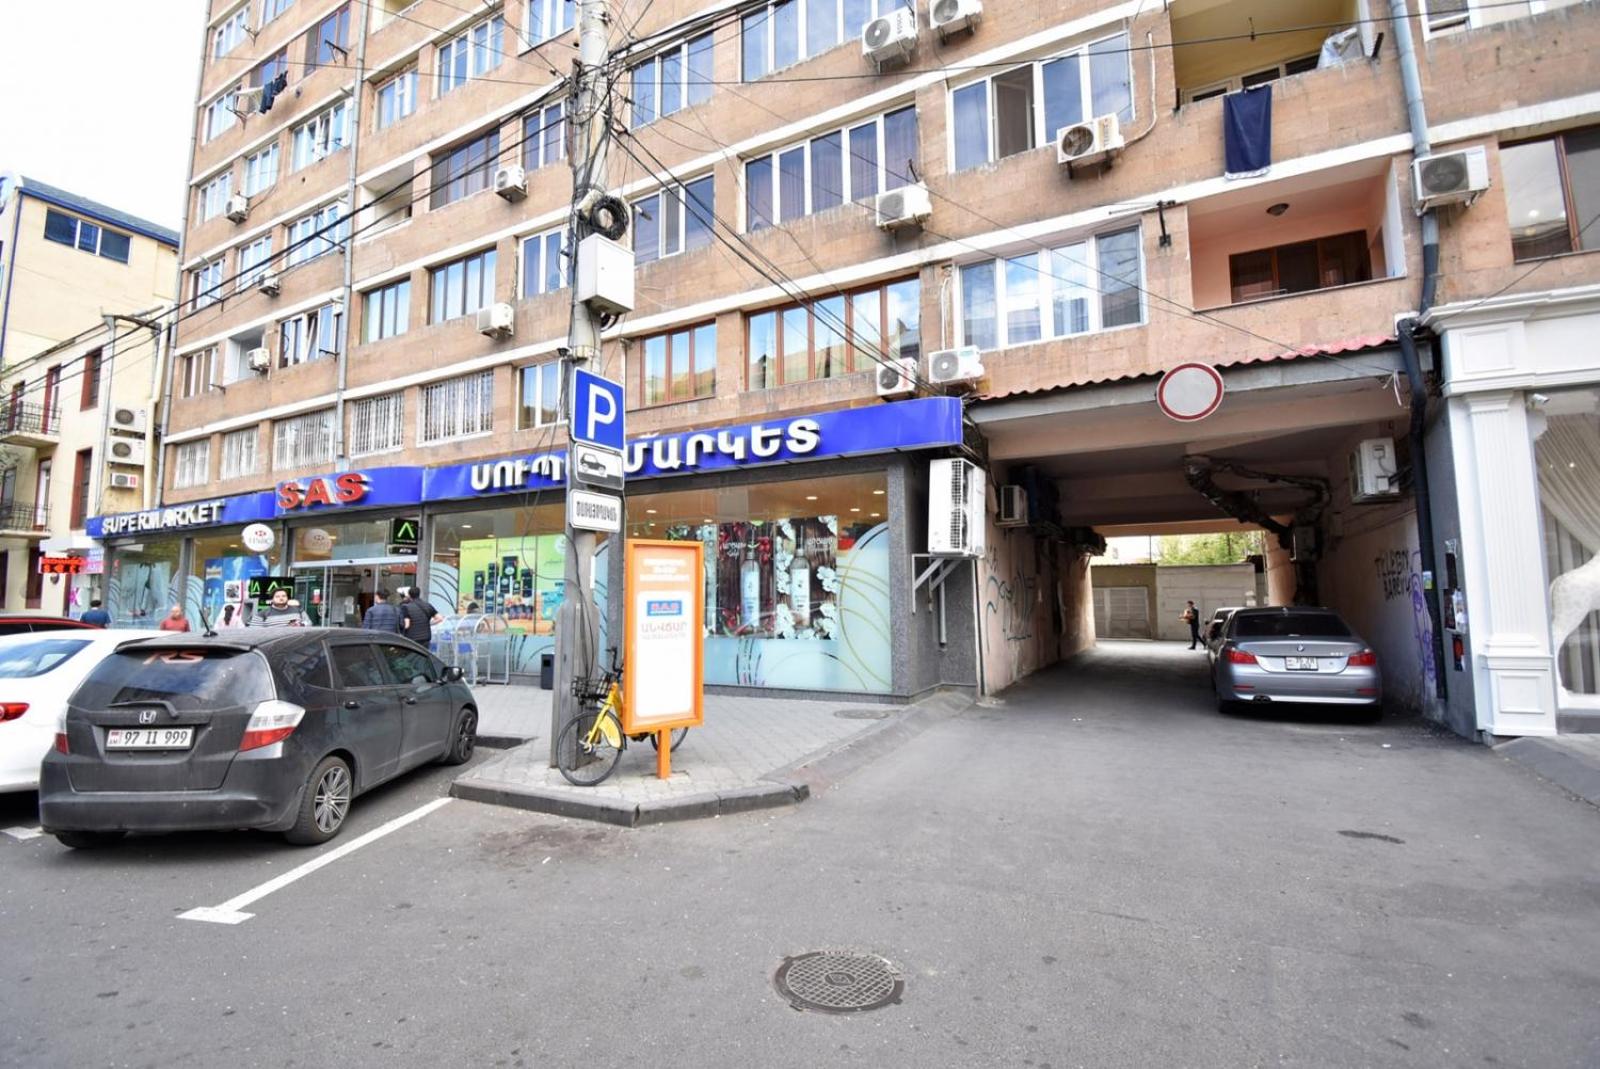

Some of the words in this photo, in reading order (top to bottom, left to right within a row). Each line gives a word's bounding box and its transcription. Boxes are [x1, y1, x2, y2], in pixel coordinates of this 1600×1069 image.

[586, 383, 617, 440] P
[471, 418, 821, 491] ՍՈՒՊՄԱՐԿԵՏ
[277, 472, 367, 509] SAS
[101, 499, 223, 535] SUPERMARKET
[124, 731, 140, 745] 97
[164, 730, 188, 745] 999
